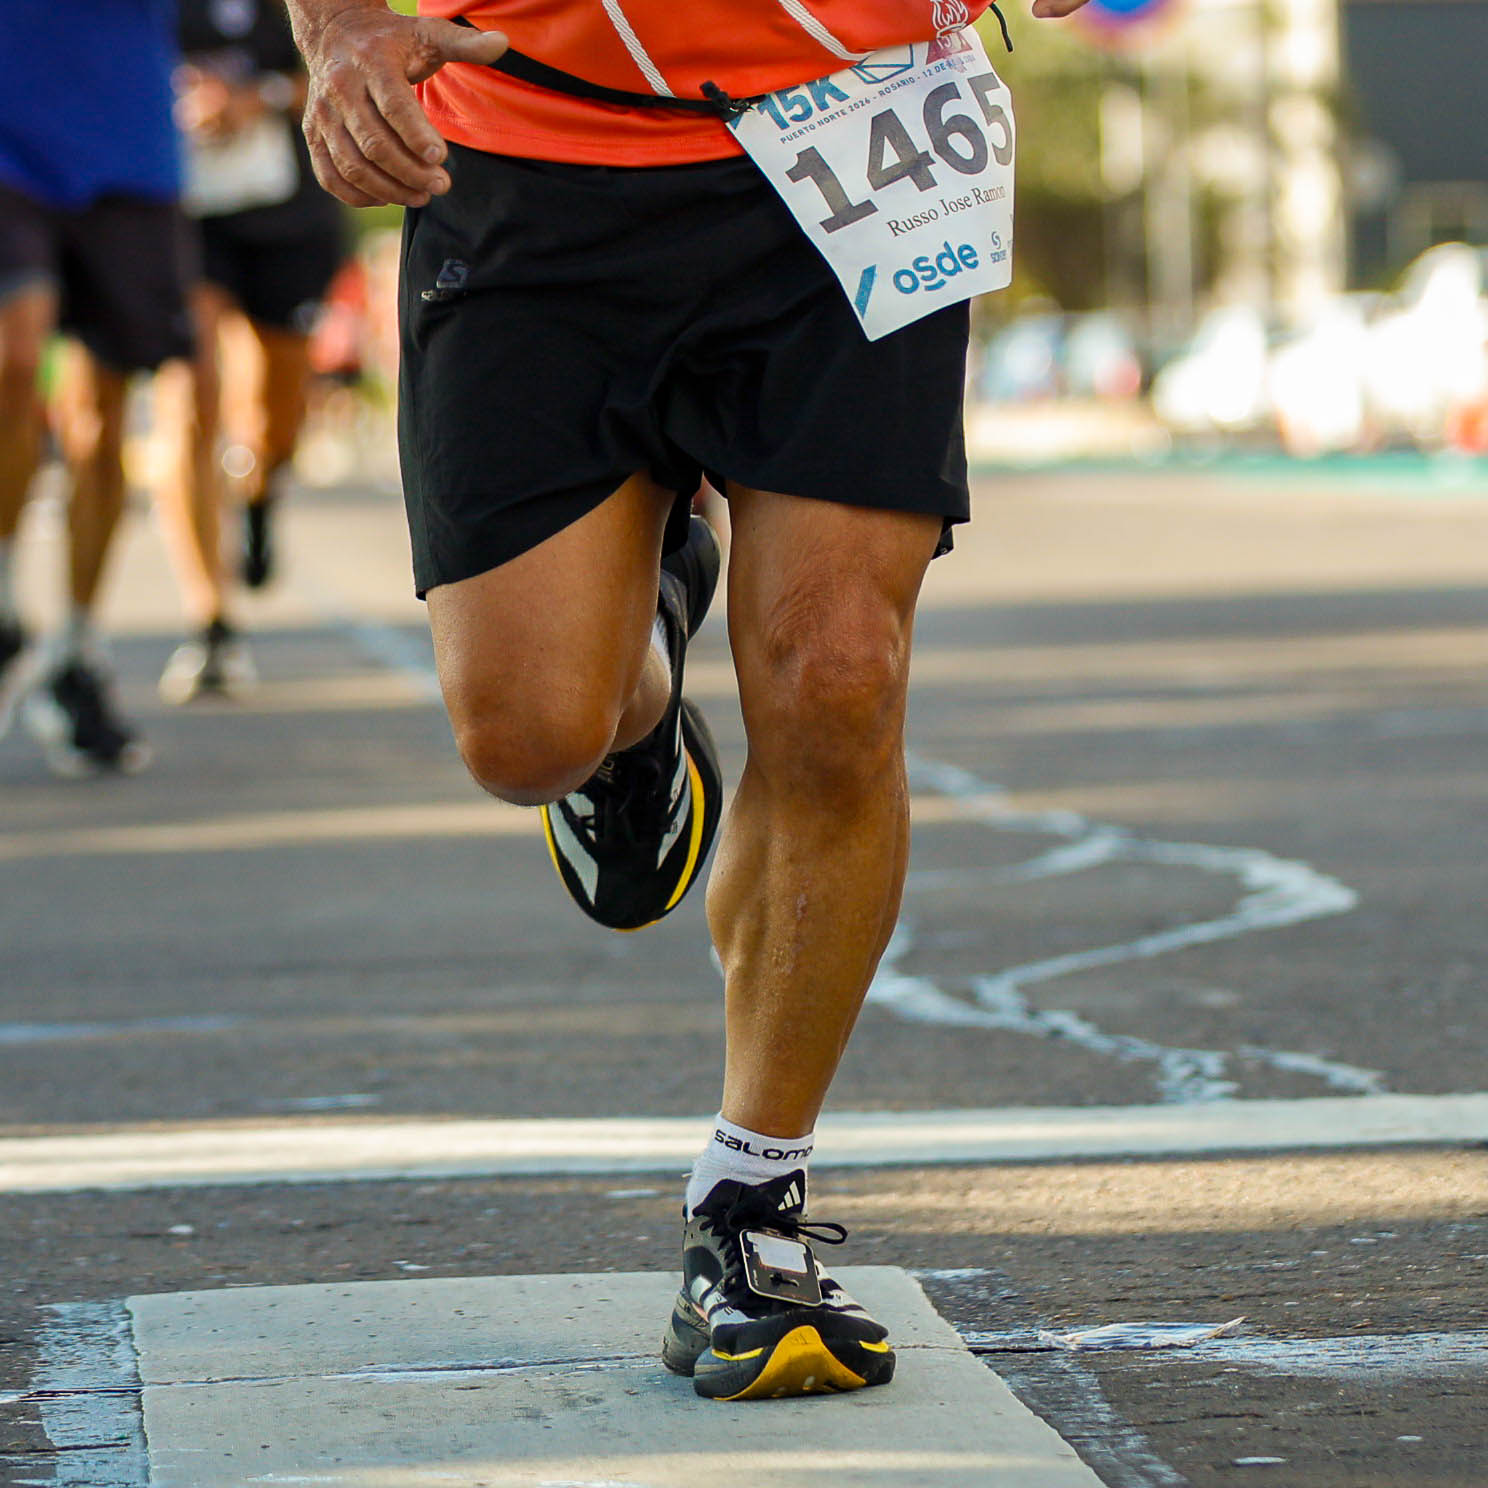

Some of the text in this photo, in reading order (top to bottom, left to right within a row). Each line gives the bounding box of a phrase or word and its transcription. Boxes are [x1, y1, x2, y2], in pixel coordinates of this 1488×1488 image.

[756, 77, 850, 130] 15K
[780, 123, 816, 145] PUERTO
[817, 108, 848, 127] NORTE
[848, 96, 871, 113] 2026
[878, 76, 916, 99] ROSARIO
[922, 68, 933, 78] 12
[934, 62, 946, 73] DE
[785, 72, 1013, 234] 1465
[886, 208, 939, 237] Russo
[939, 195, 973, 216] Jose
[893, 240, 980, 293] osde
